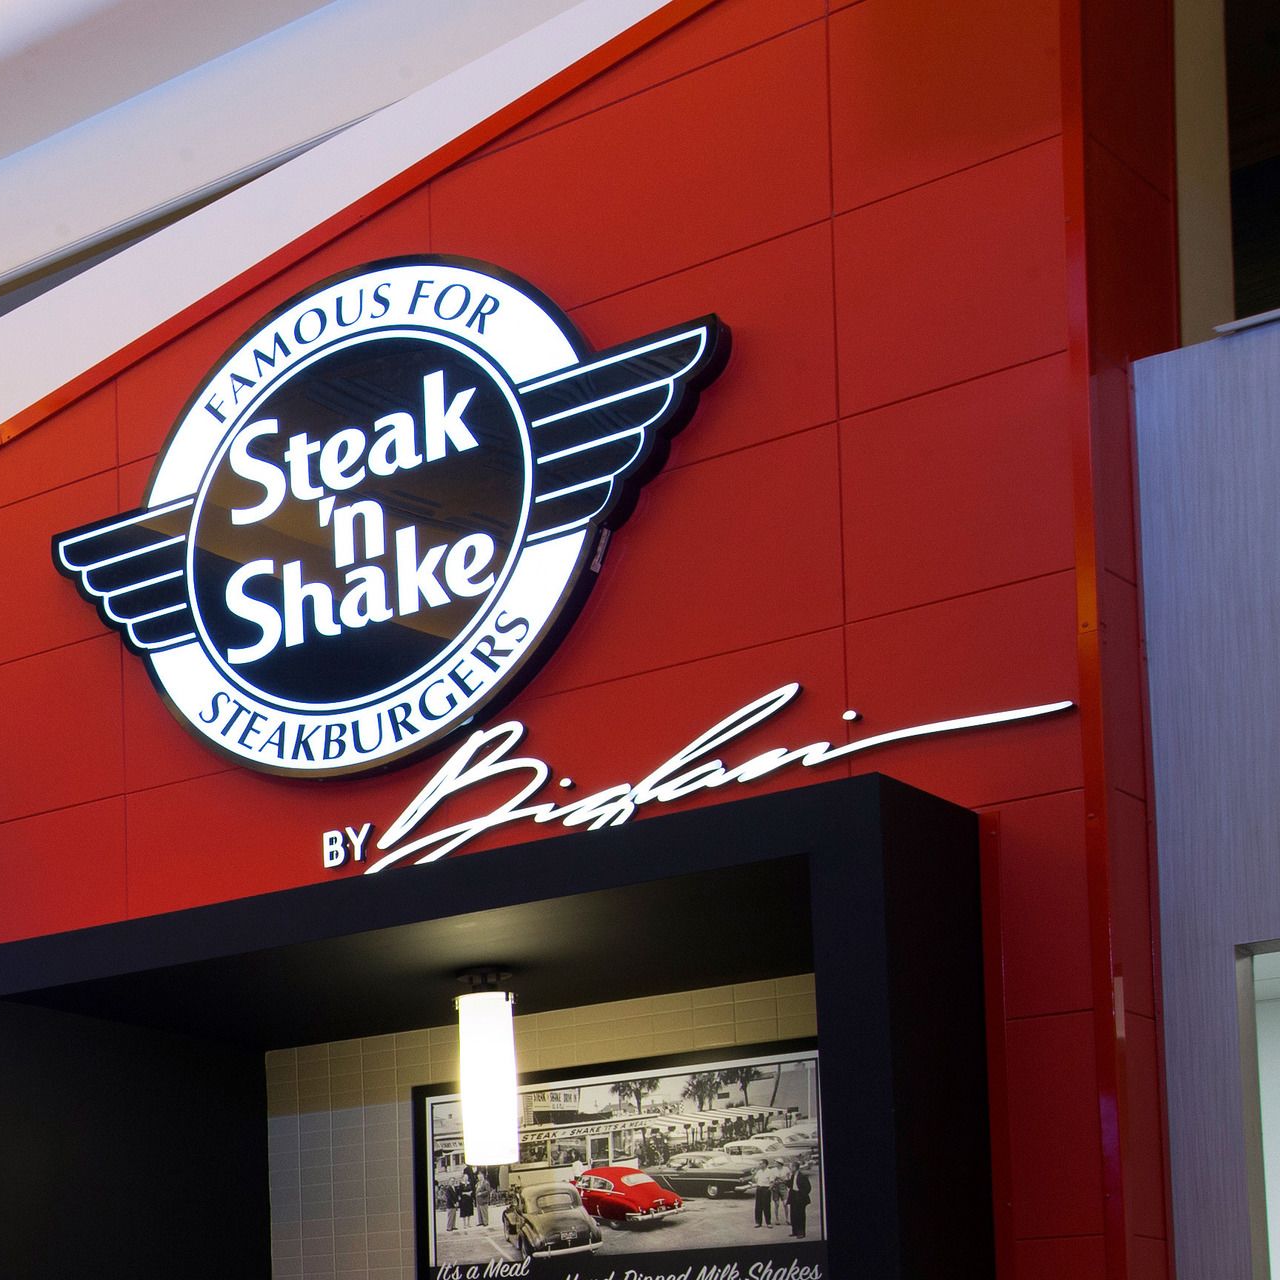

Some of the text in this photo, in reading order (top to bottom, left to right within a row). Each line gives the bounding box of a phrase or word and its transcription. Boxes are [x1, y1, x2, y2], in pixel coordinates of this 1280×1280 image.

[205, 280, 500, 424] FAMOUS FOR
[228, 369, 480, 526] Steak
[226, 524, 496, 665] Shake
[198, 608, 530, 762] STEAKBURGERS
[323, 822, 372, 869] BY
[521, 1131, 557, 1142] STEAK
[569, 1126, 601, 1136] SHAKE
[466, 1265, 480, 1280] a
[483, 1256, 531, 1279] Meal
